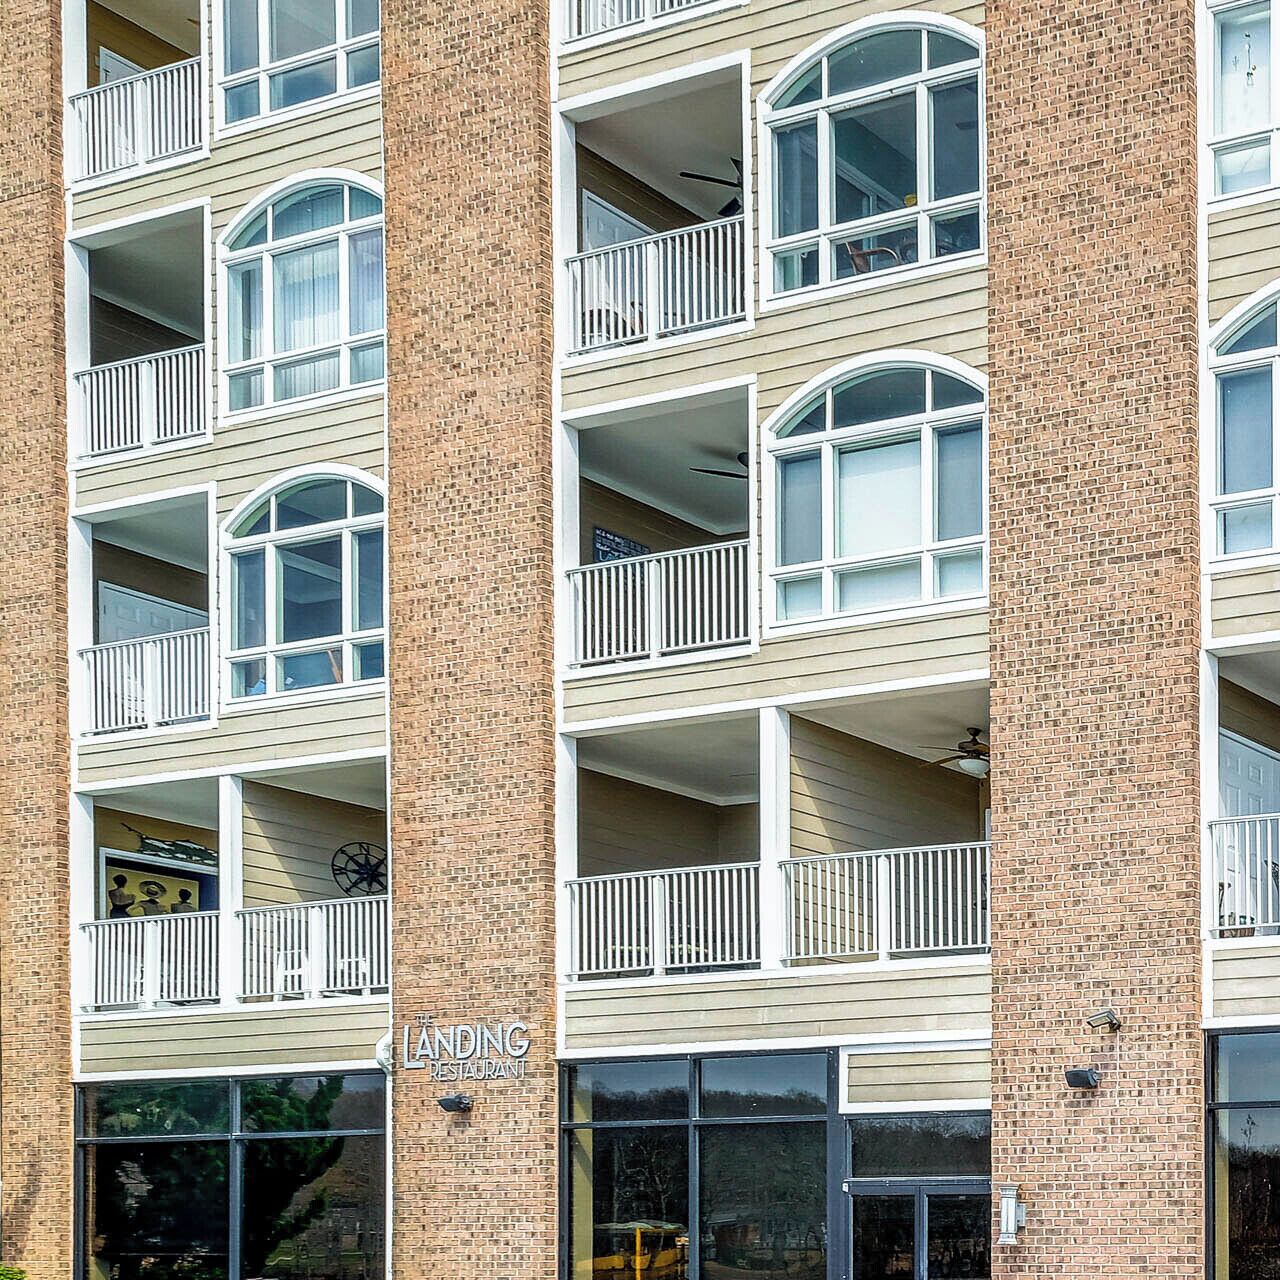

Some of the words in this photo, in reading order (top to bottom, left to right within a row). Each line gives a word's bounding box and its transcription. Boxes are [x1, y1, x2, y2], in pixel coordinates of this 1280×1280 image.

[415, 1013, 434, 1026] THE
[403, 1021, 531, 1069] LANDING
[429, 1058, 528, 1081] RESTAURANT
